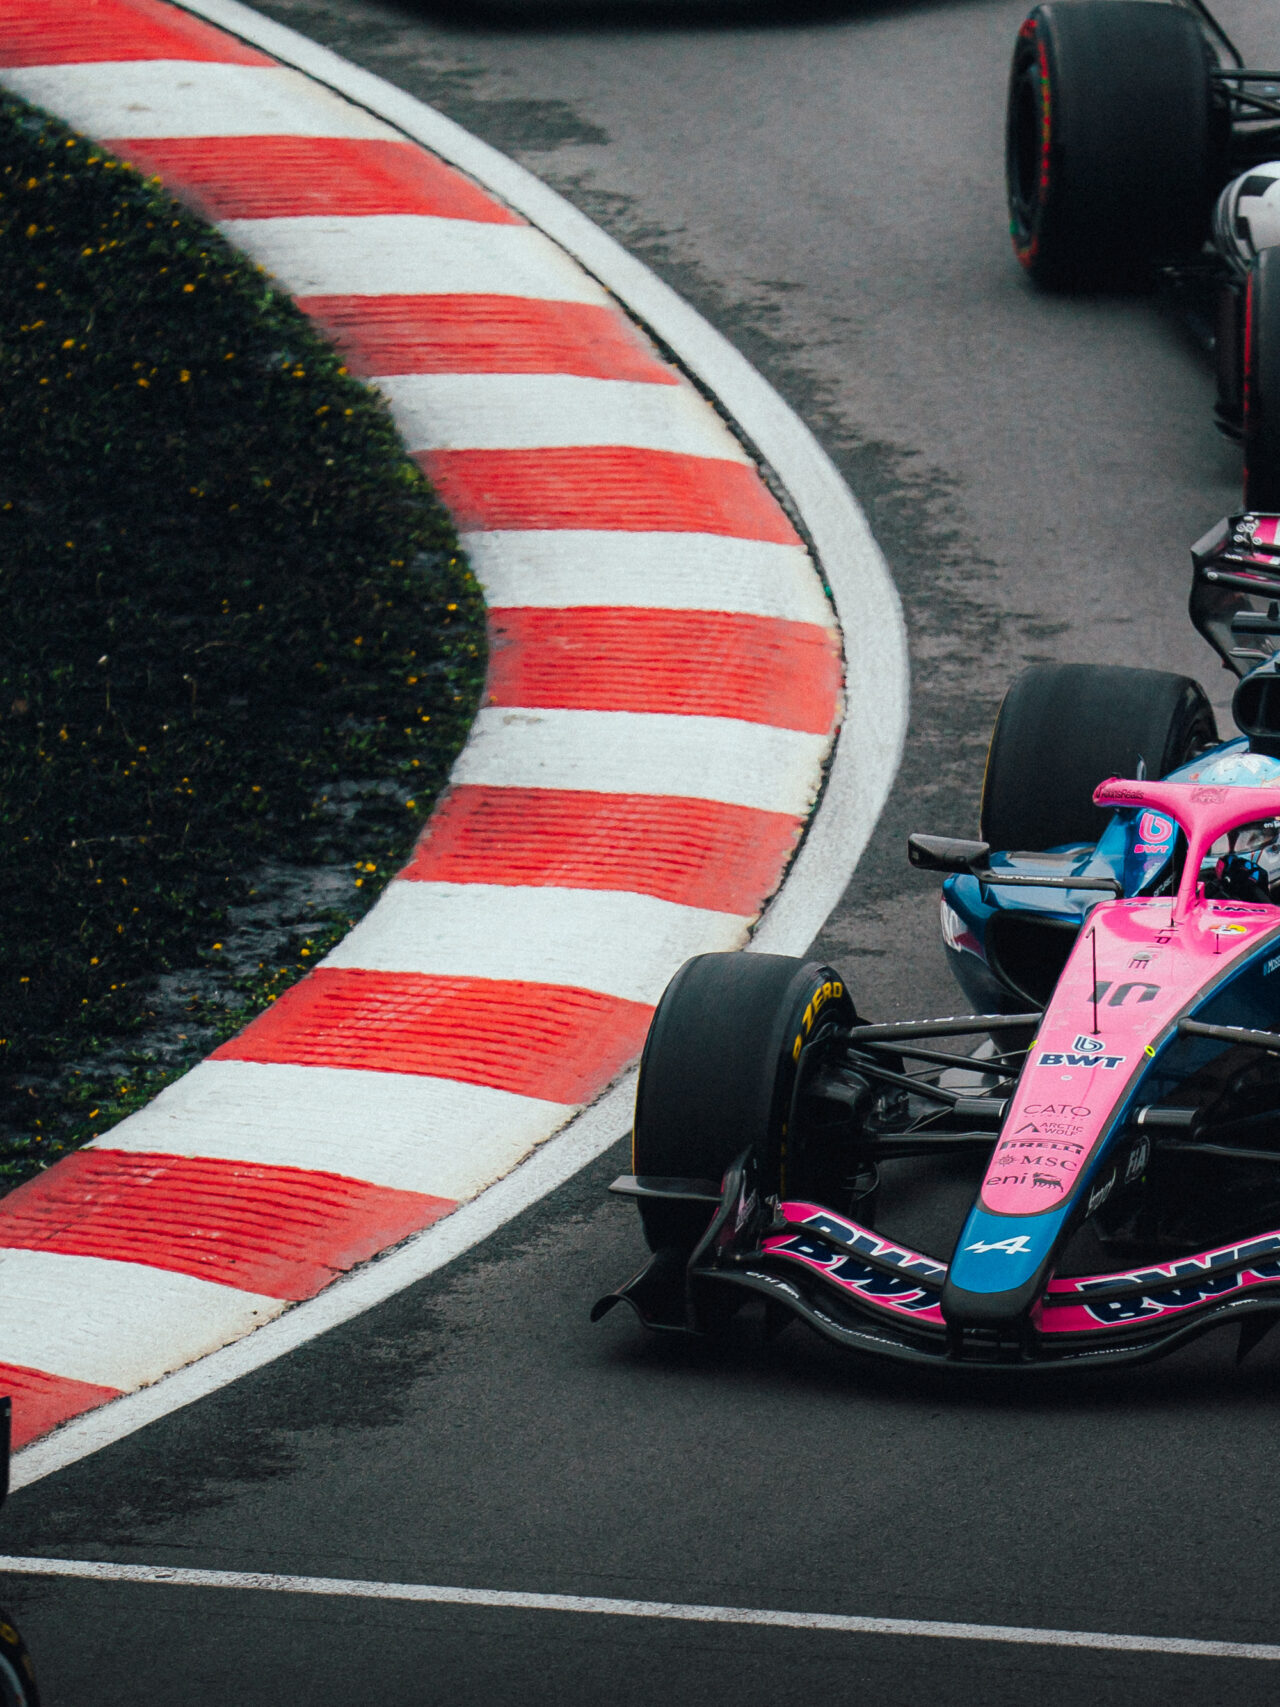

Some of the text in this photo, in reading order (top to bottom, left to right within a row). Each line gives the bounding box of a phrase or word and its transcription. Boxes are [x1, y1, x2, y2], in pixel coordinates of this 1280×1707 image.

[1037, 1053, 1127, 1071] BWT
[1023, 1104, 1092, 1117] CATO
[1040, 1122, 1085, 1133] ARCTIC
[1044, 1127, 1079, 1137] WOLF
[999, 1138, 1085, 1155] PIRELLI
[1020, 1155, 1078, 1172] MSC
[986, 1172, 1029, 1186] eni
